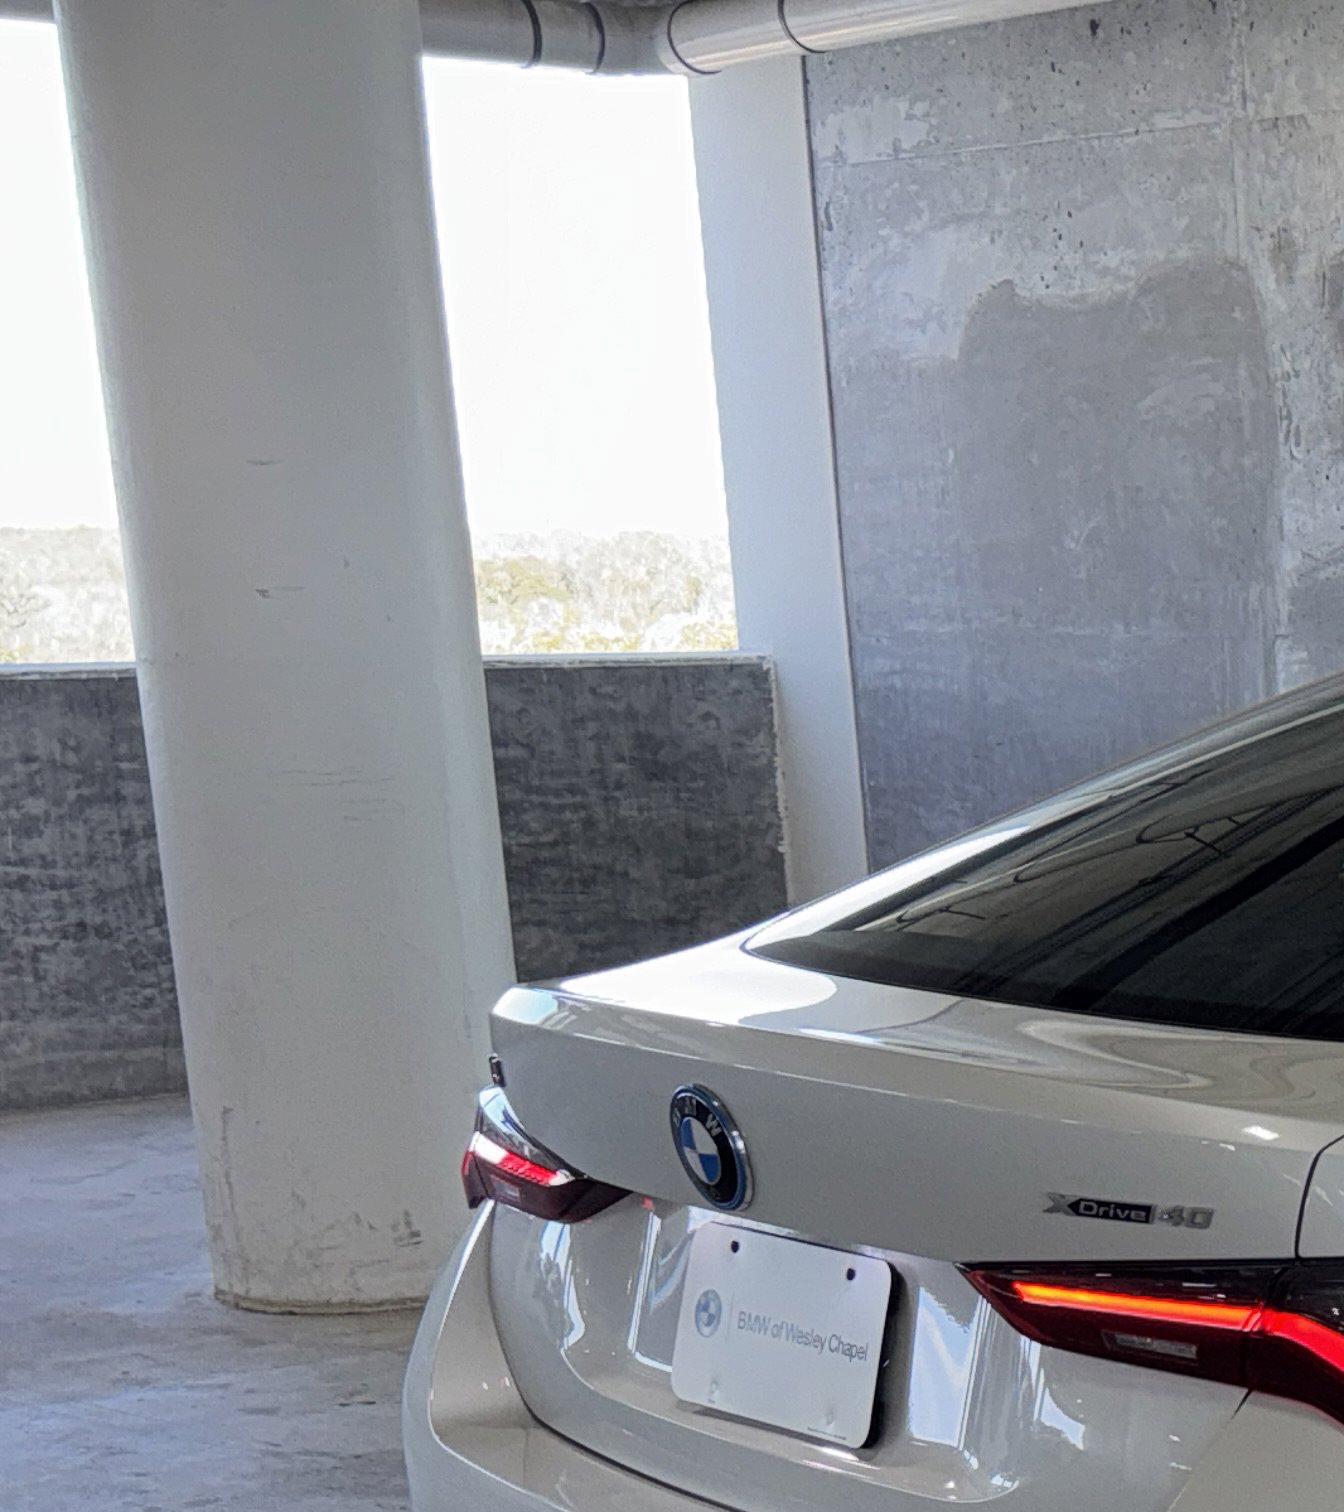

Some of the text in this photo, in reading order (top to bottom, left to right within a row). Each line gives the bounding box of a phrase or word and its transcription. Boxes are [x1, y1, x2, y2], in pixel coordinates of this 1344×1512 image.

[1158, 1205, 1215, 1229] 40
[737, 1311, 869, 1362] BMW of Wesley Chapel
